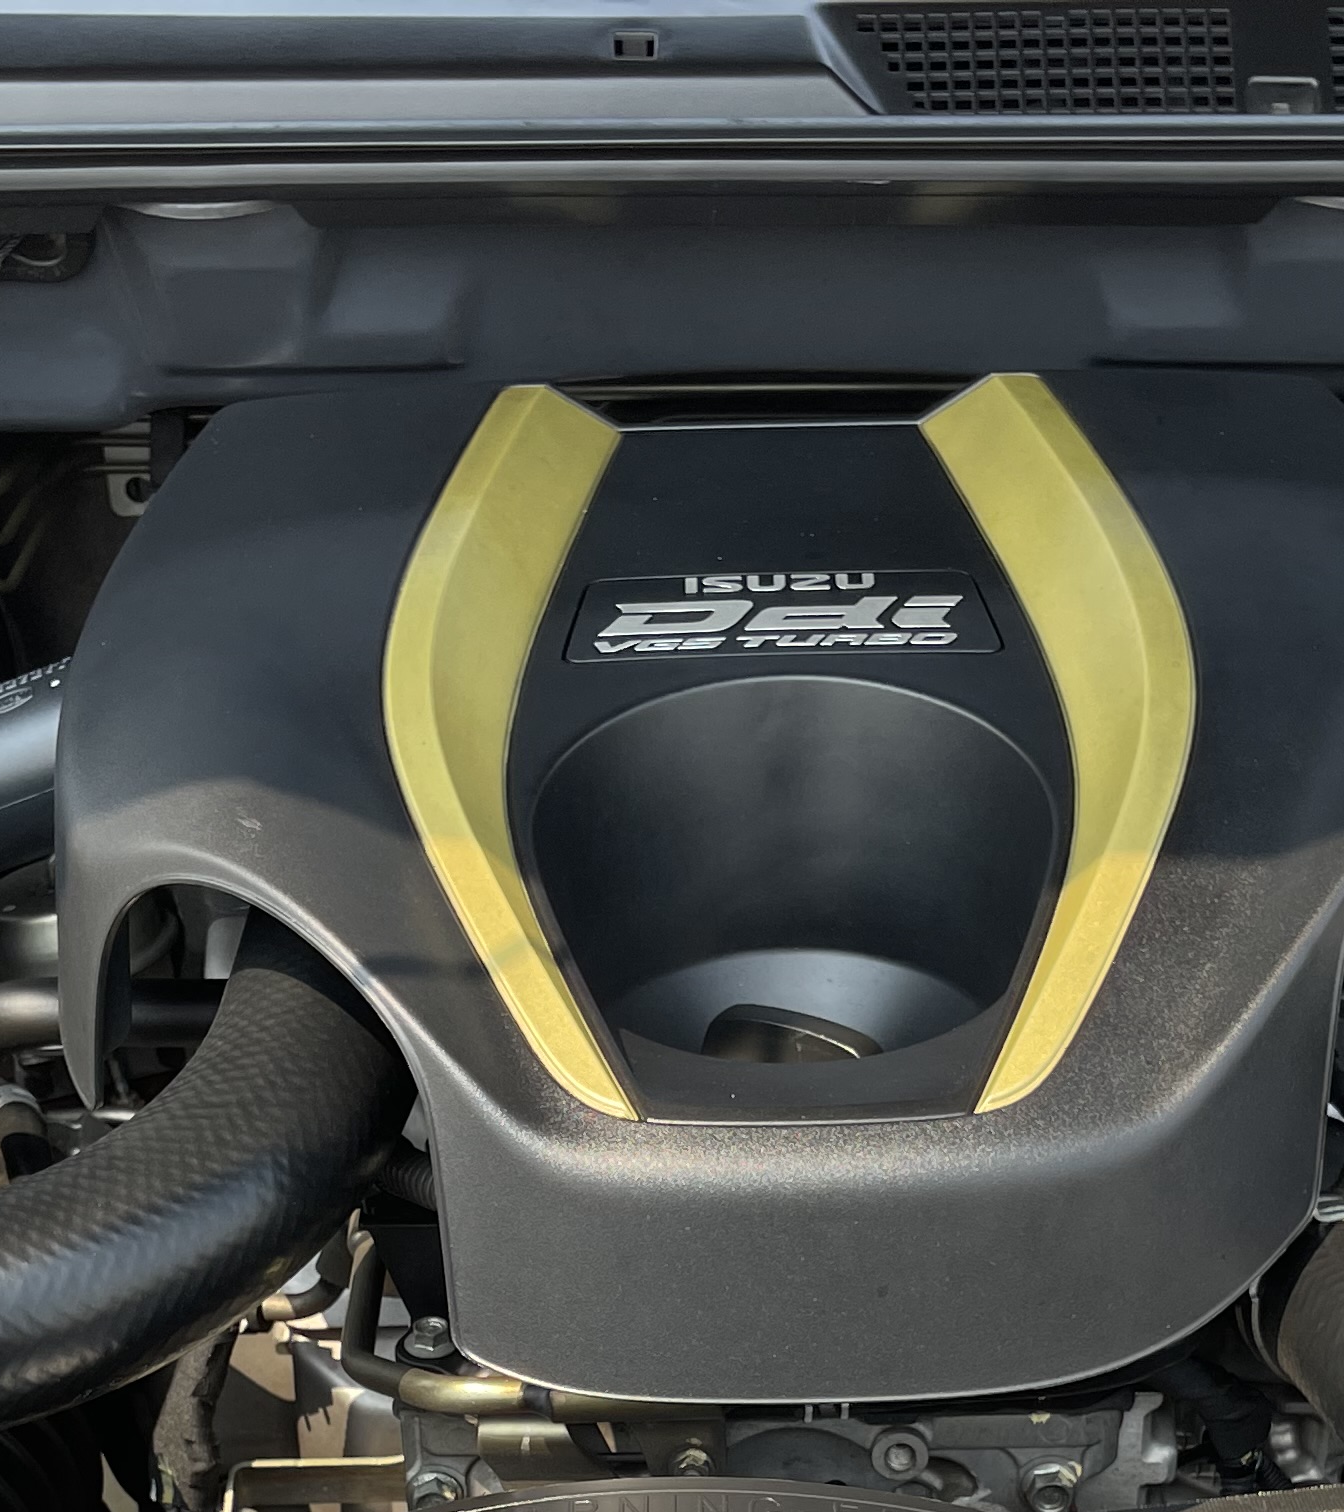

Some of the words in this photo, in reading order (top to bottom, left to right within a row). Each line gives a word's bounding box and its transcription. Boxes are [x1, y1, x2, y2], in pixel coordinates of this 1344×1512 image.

[684, 573, 875, 594] ISUZU
[594, 637, 727, 653] VGS
[736, 632, 958, 648] TURBO
